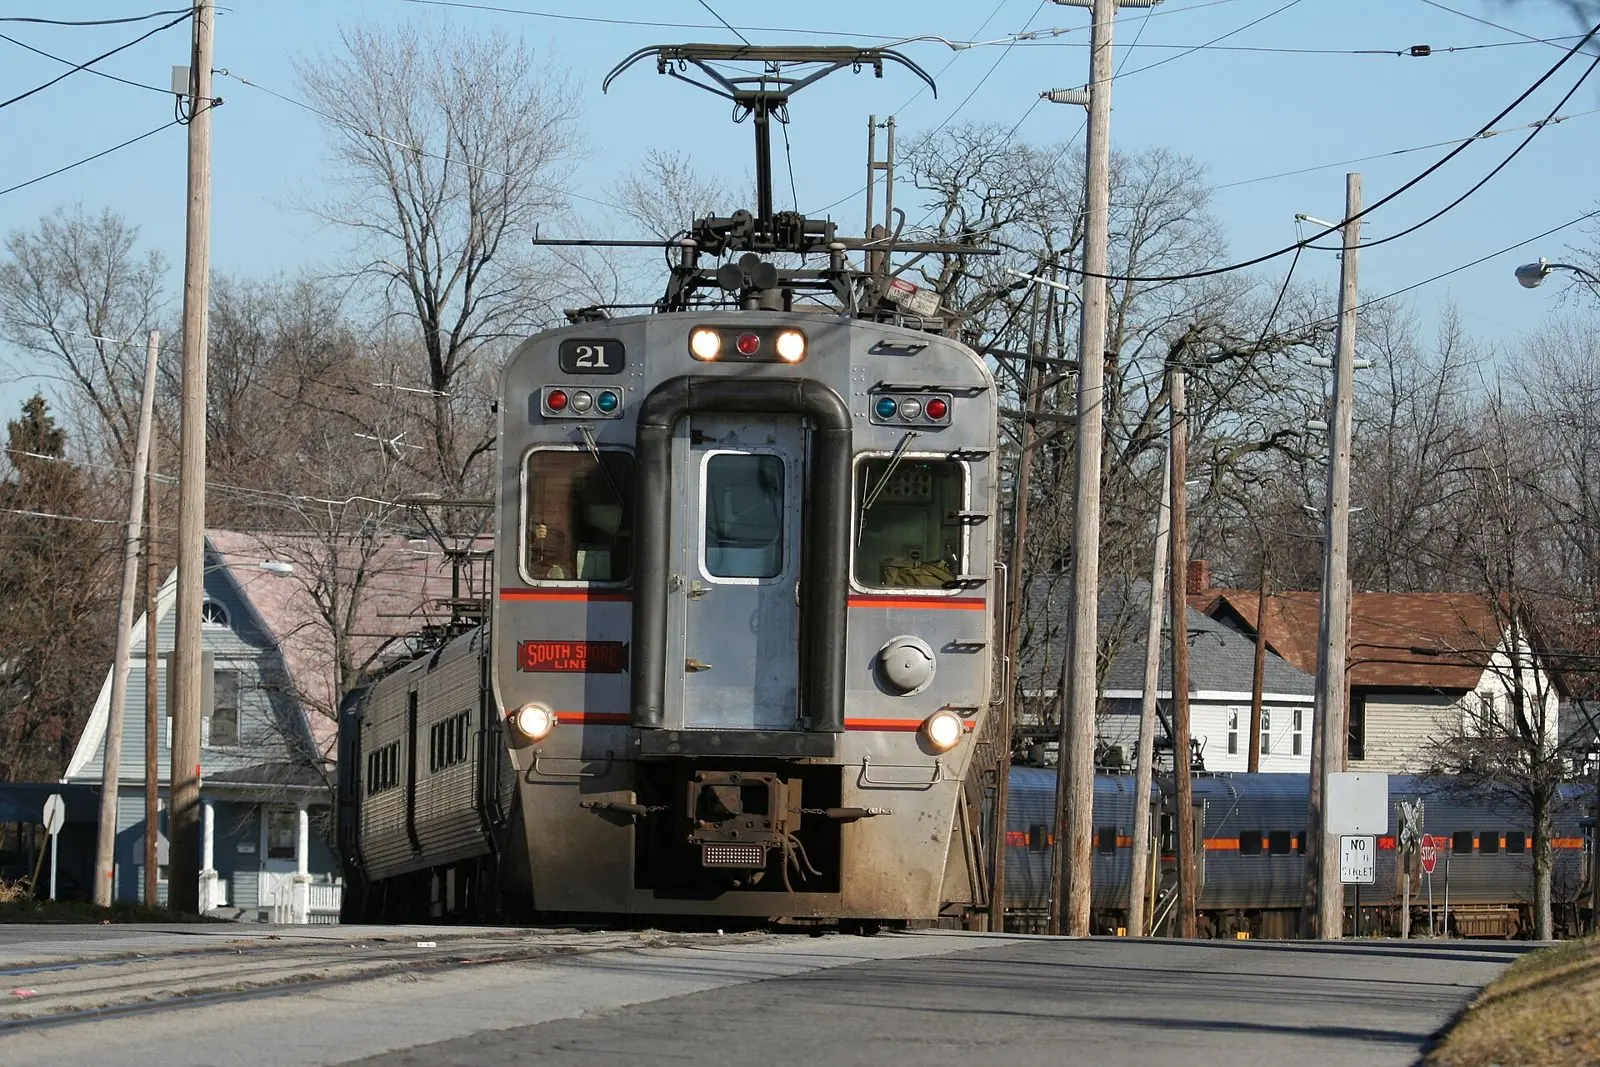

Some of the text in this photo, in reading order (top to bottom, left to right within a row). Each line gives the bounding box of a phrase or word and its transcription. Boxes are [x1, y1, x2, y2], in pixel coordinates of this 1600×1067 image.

[576, 345, 609, 367] 21
[527, 644, 619, 669] SOUTH SHORE
[554, 659, 588, 669] LINE
[1350, 839, 1366, 851] NO
[1422, 846, 1435, 860] STOP
